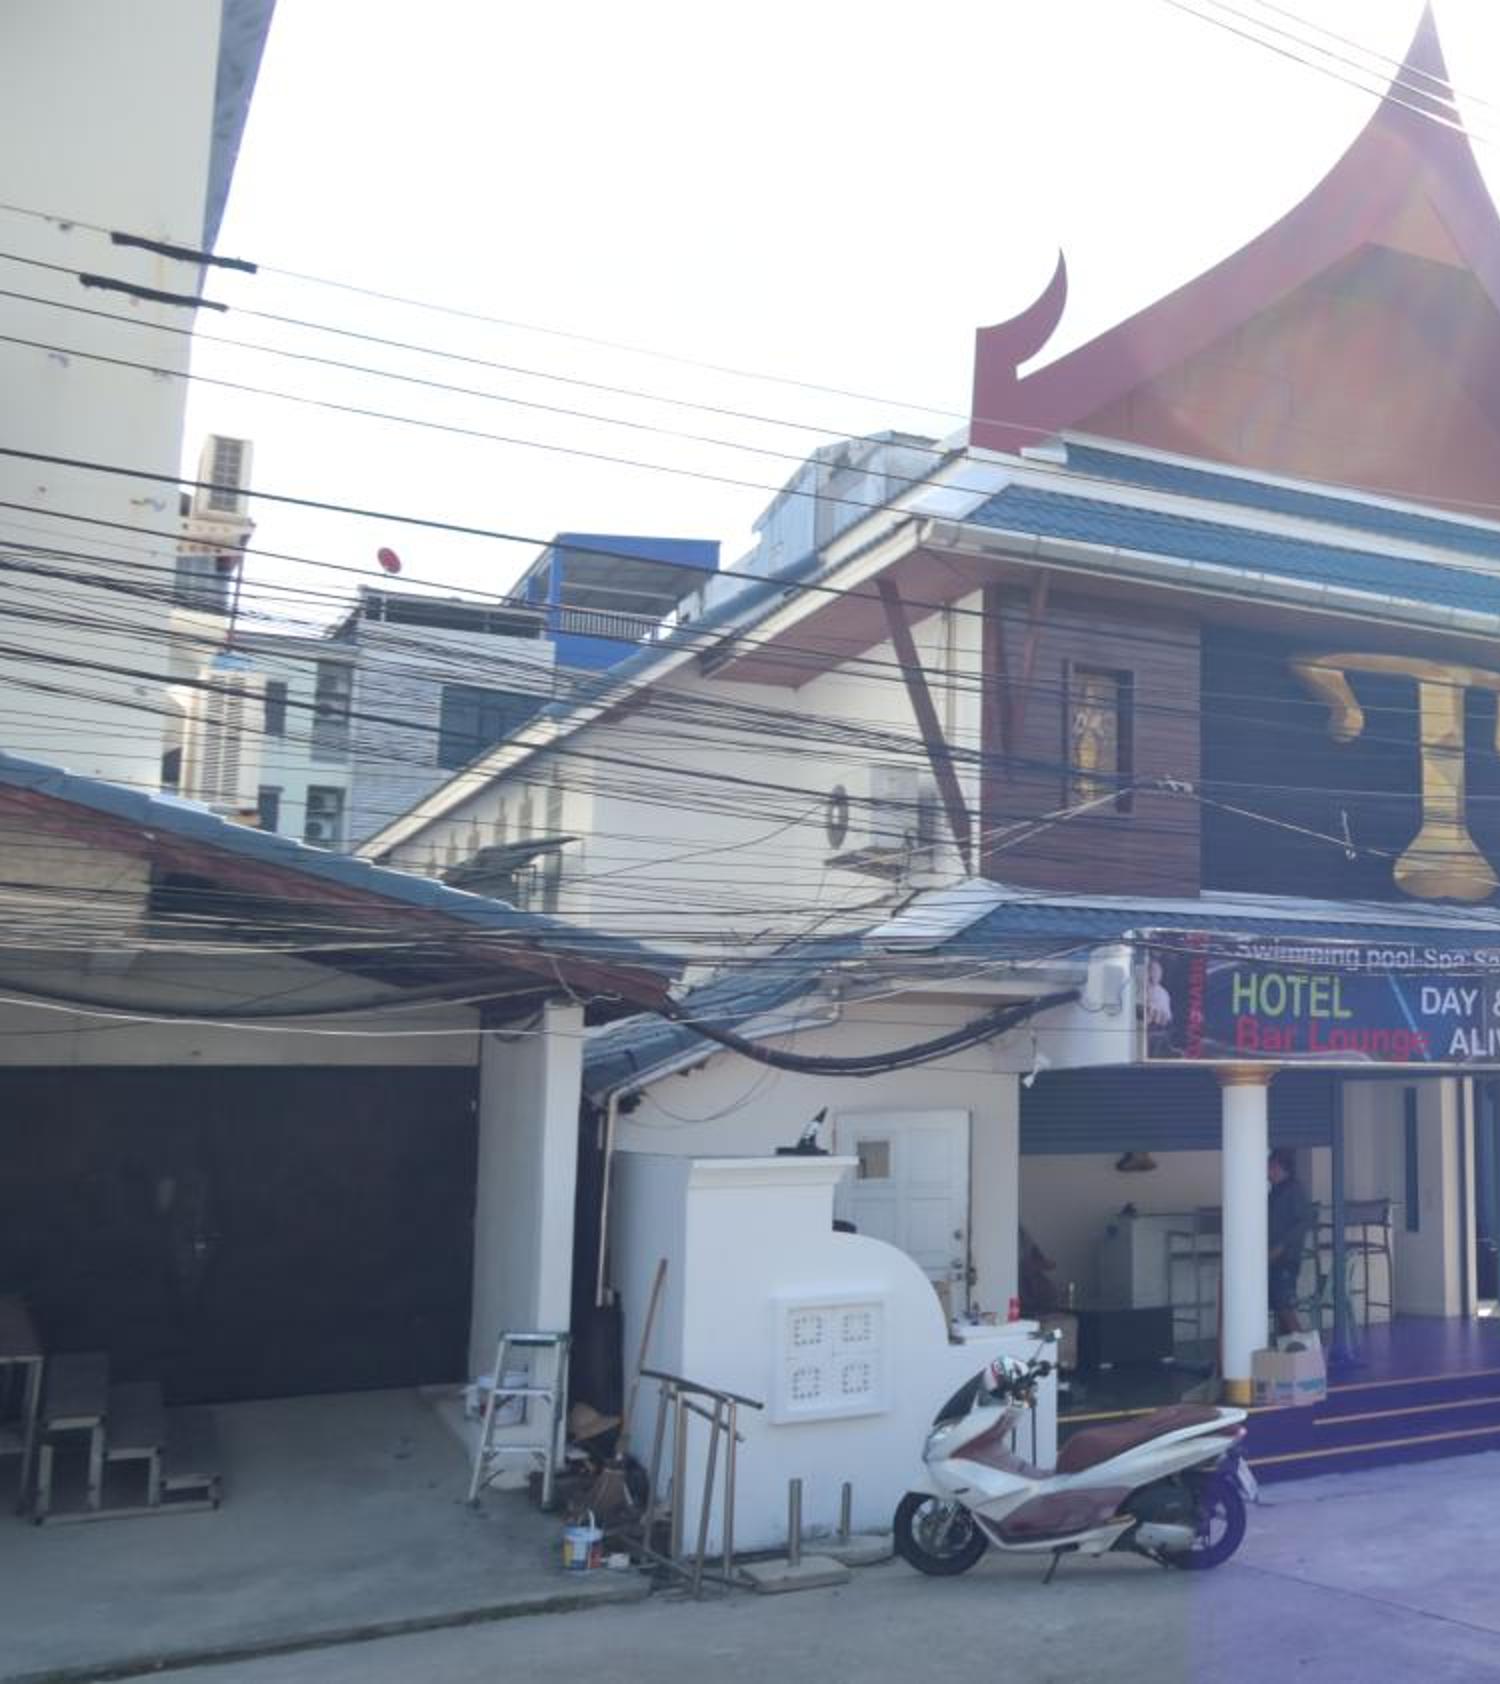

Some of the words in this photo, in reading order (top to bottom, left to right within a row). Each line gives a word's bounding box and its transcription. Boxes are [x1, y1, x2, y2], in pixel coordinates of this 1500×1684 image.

[1231, 972, 1354, 1019] HOTEL
[1421, 987, 1478, 1016] DAY
[1235, 1015, 1295, 1055] Bar
[1308, 1018, 1432, 1063] Lounge
